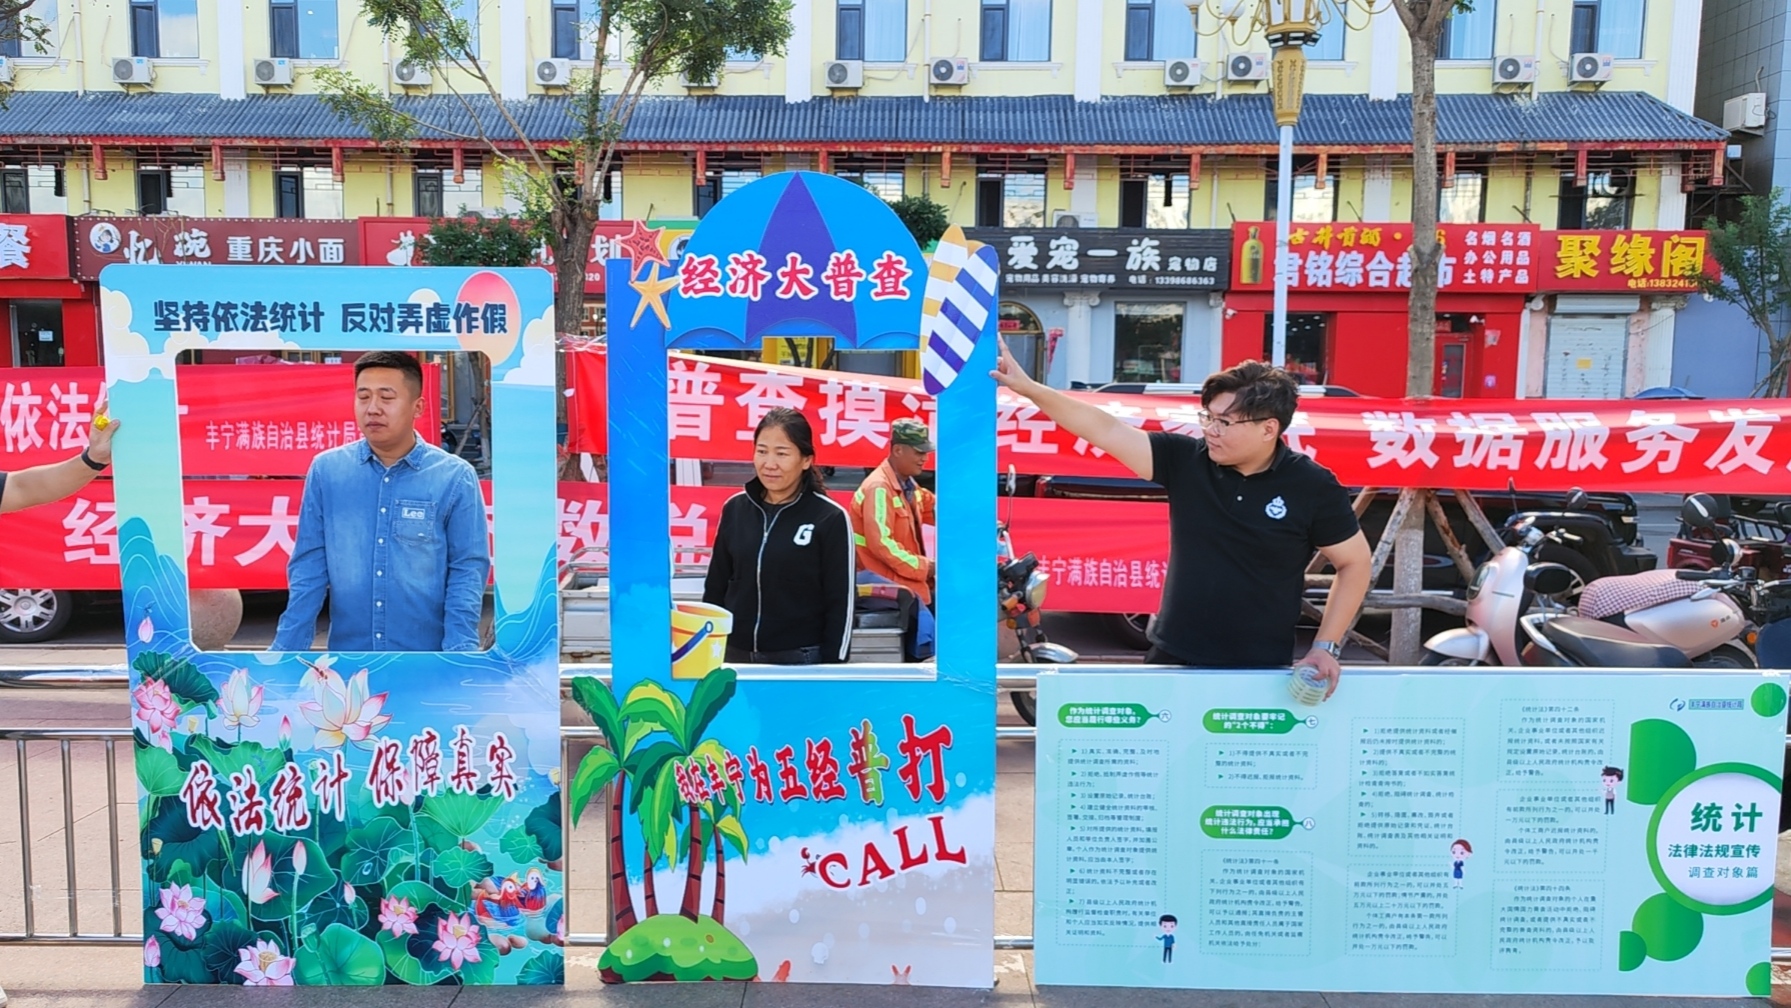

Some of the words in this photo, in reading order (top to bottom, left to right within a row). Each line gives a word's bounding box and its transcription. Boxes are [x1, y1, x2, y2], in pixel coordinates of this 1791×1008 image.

[226, 236, 345, 264] 重庆小面
[1007, 235, 1161, 271] 爱宠一族
[1167, 256, 1218, 272] 宠物店
[1464, 230, 1532, 247] 名烟名酒
[1463, 249, 1531, 265] 办公用品
[1555, 233, 1706, 278] 聚缘阁
[680, 252, 912, 299] 经济大普查
[1462, 268, 1530, 284] 土特产品
[153, 300, 325, 334] 坚持依法统计
[341, 300, 508, 335] 反对弄虚作假
[1361, 408, 1791, 475] 数据服务发
[403, 508, 424, 518] Lee
[793, 523, 815, 546] G
[1040, 556, 1167, 589] 丰宁满族自治县统
[183, 751, 349, 836] 依法统计
[367, 728, 518, 805] 保障真实
[1690, 802, 1763, 832] 统计
[818, 816, 967, 888] CALL
[1668, 843, 1761, 858] 法律法规宣传
[1688, 866, 1759, 878] 调查对象篇
